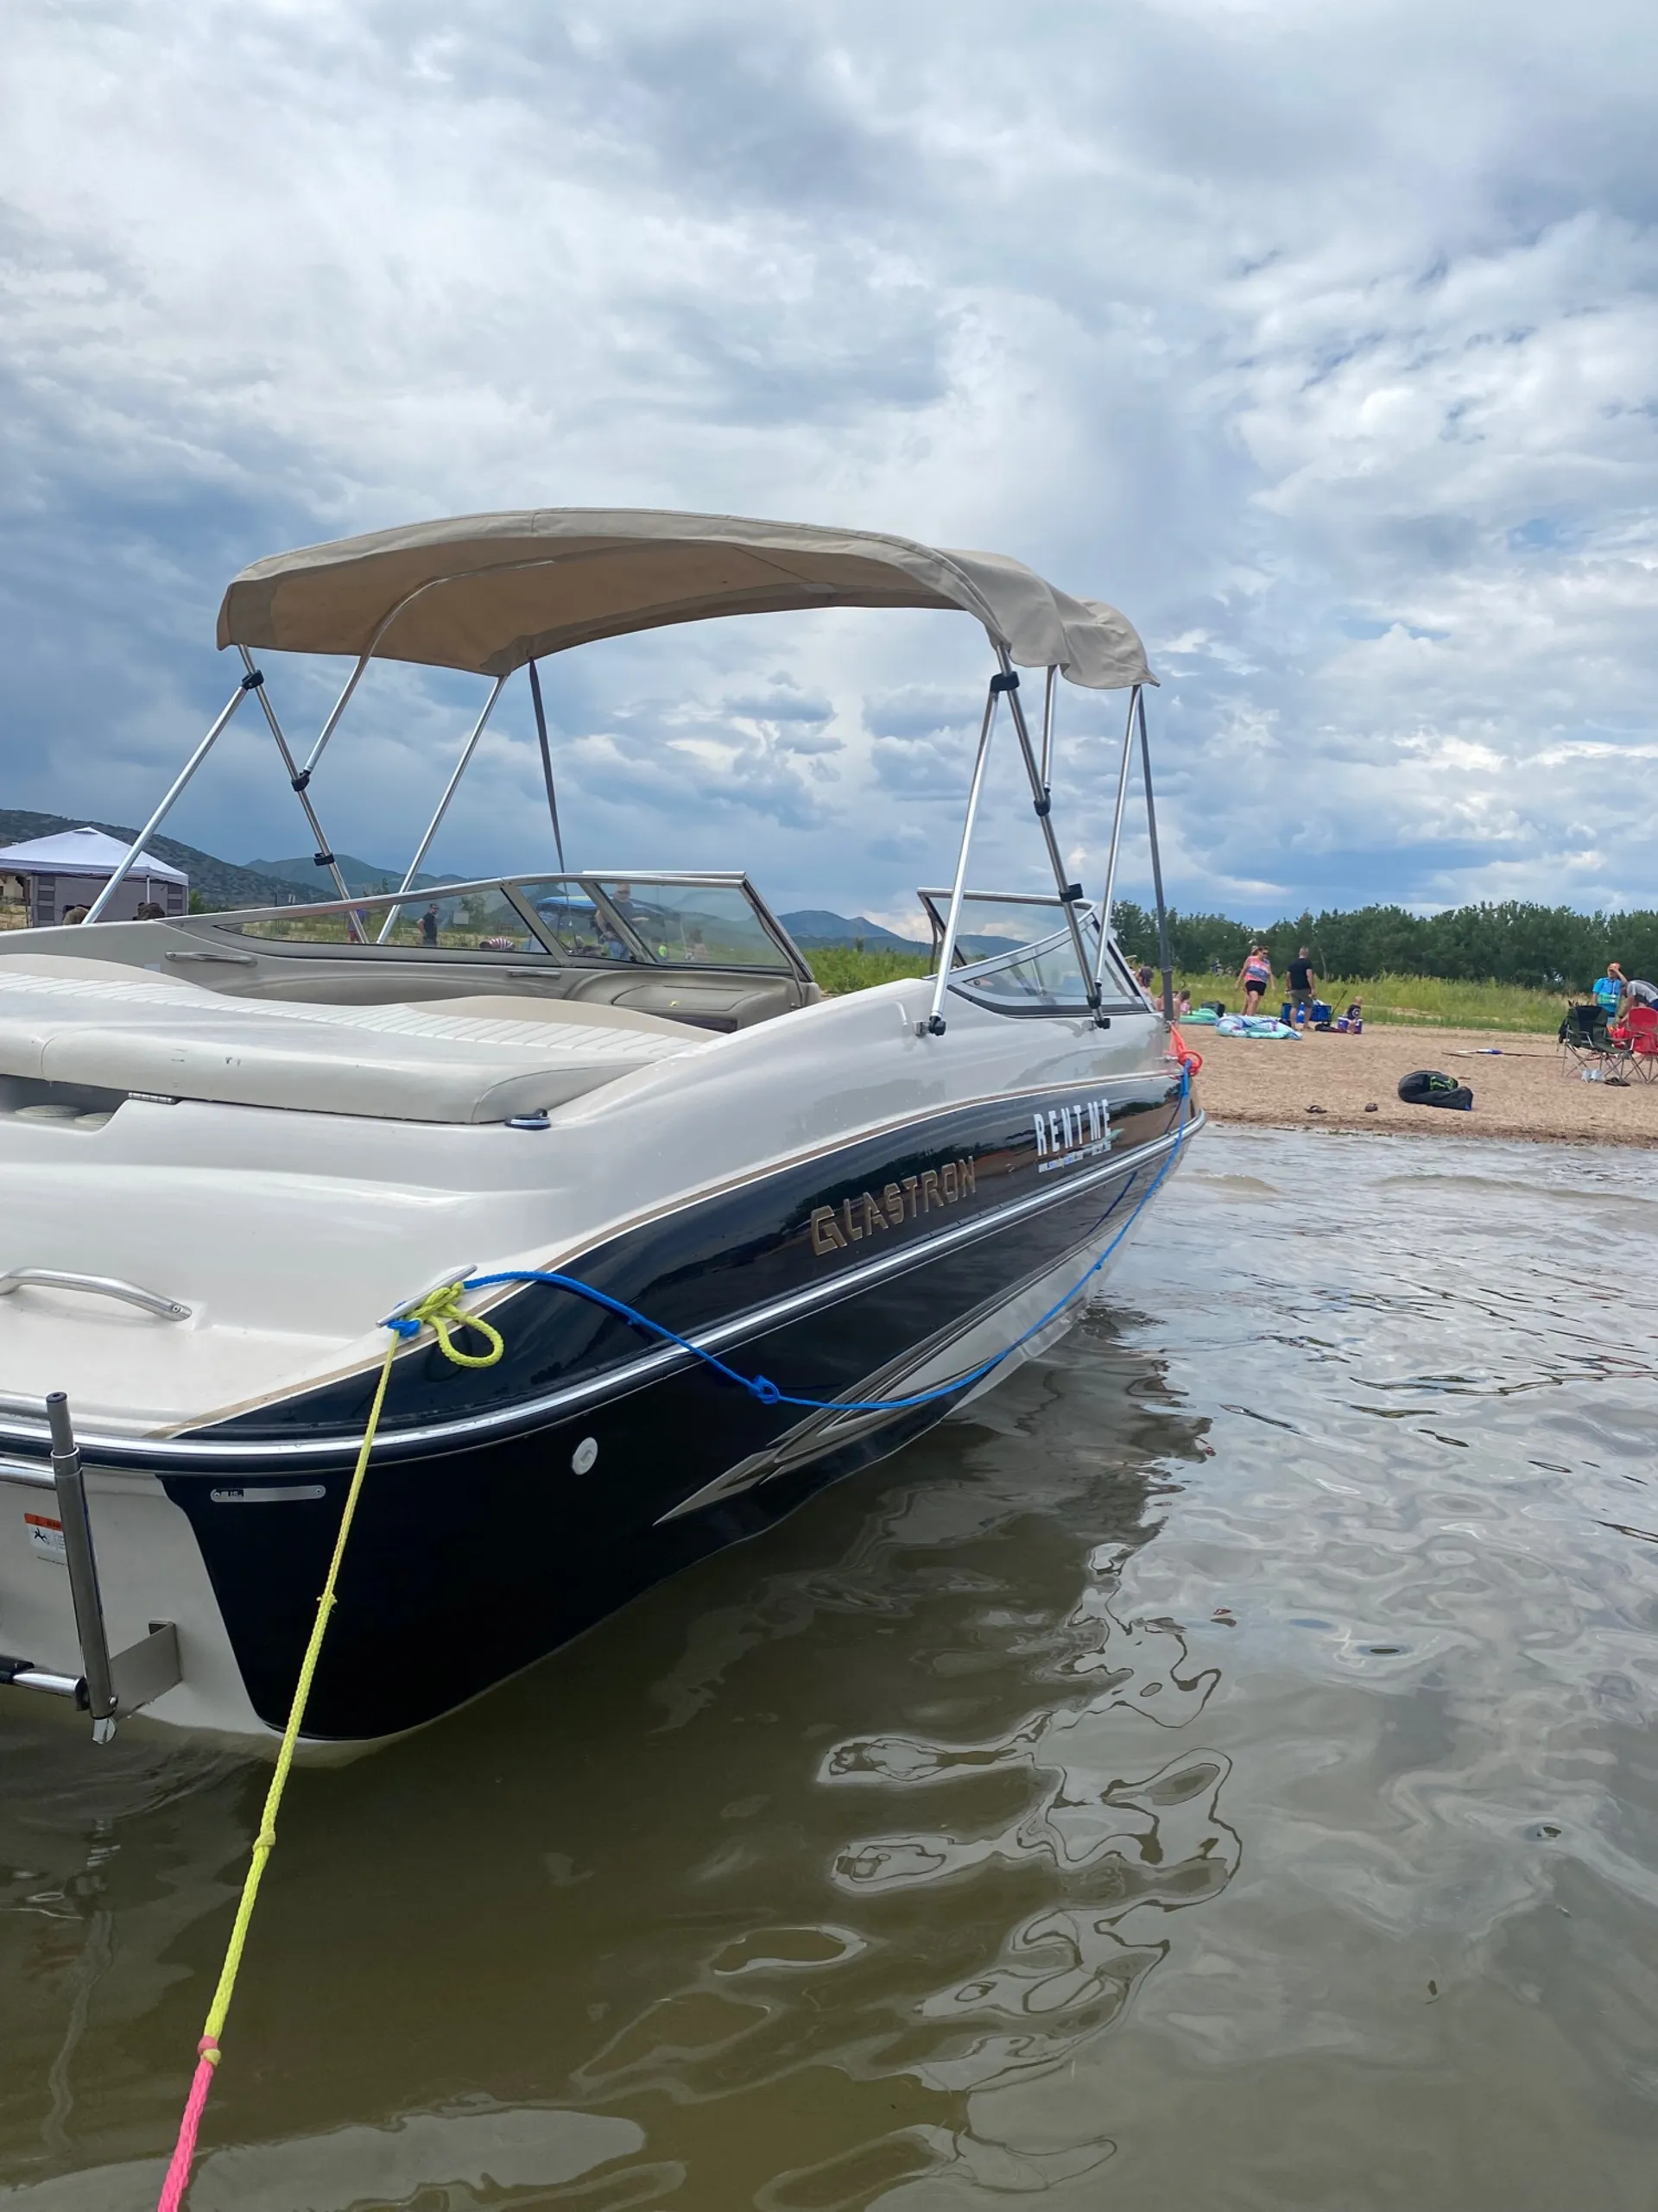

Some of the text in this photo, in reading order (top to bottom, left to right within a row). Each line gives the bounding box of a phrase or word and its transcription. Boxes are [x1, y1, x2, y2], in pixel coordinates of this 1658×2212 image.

[1034, 1098, 1111, 1156] RENT ME
[810, 1155, 977, 1256] GLASTRON
